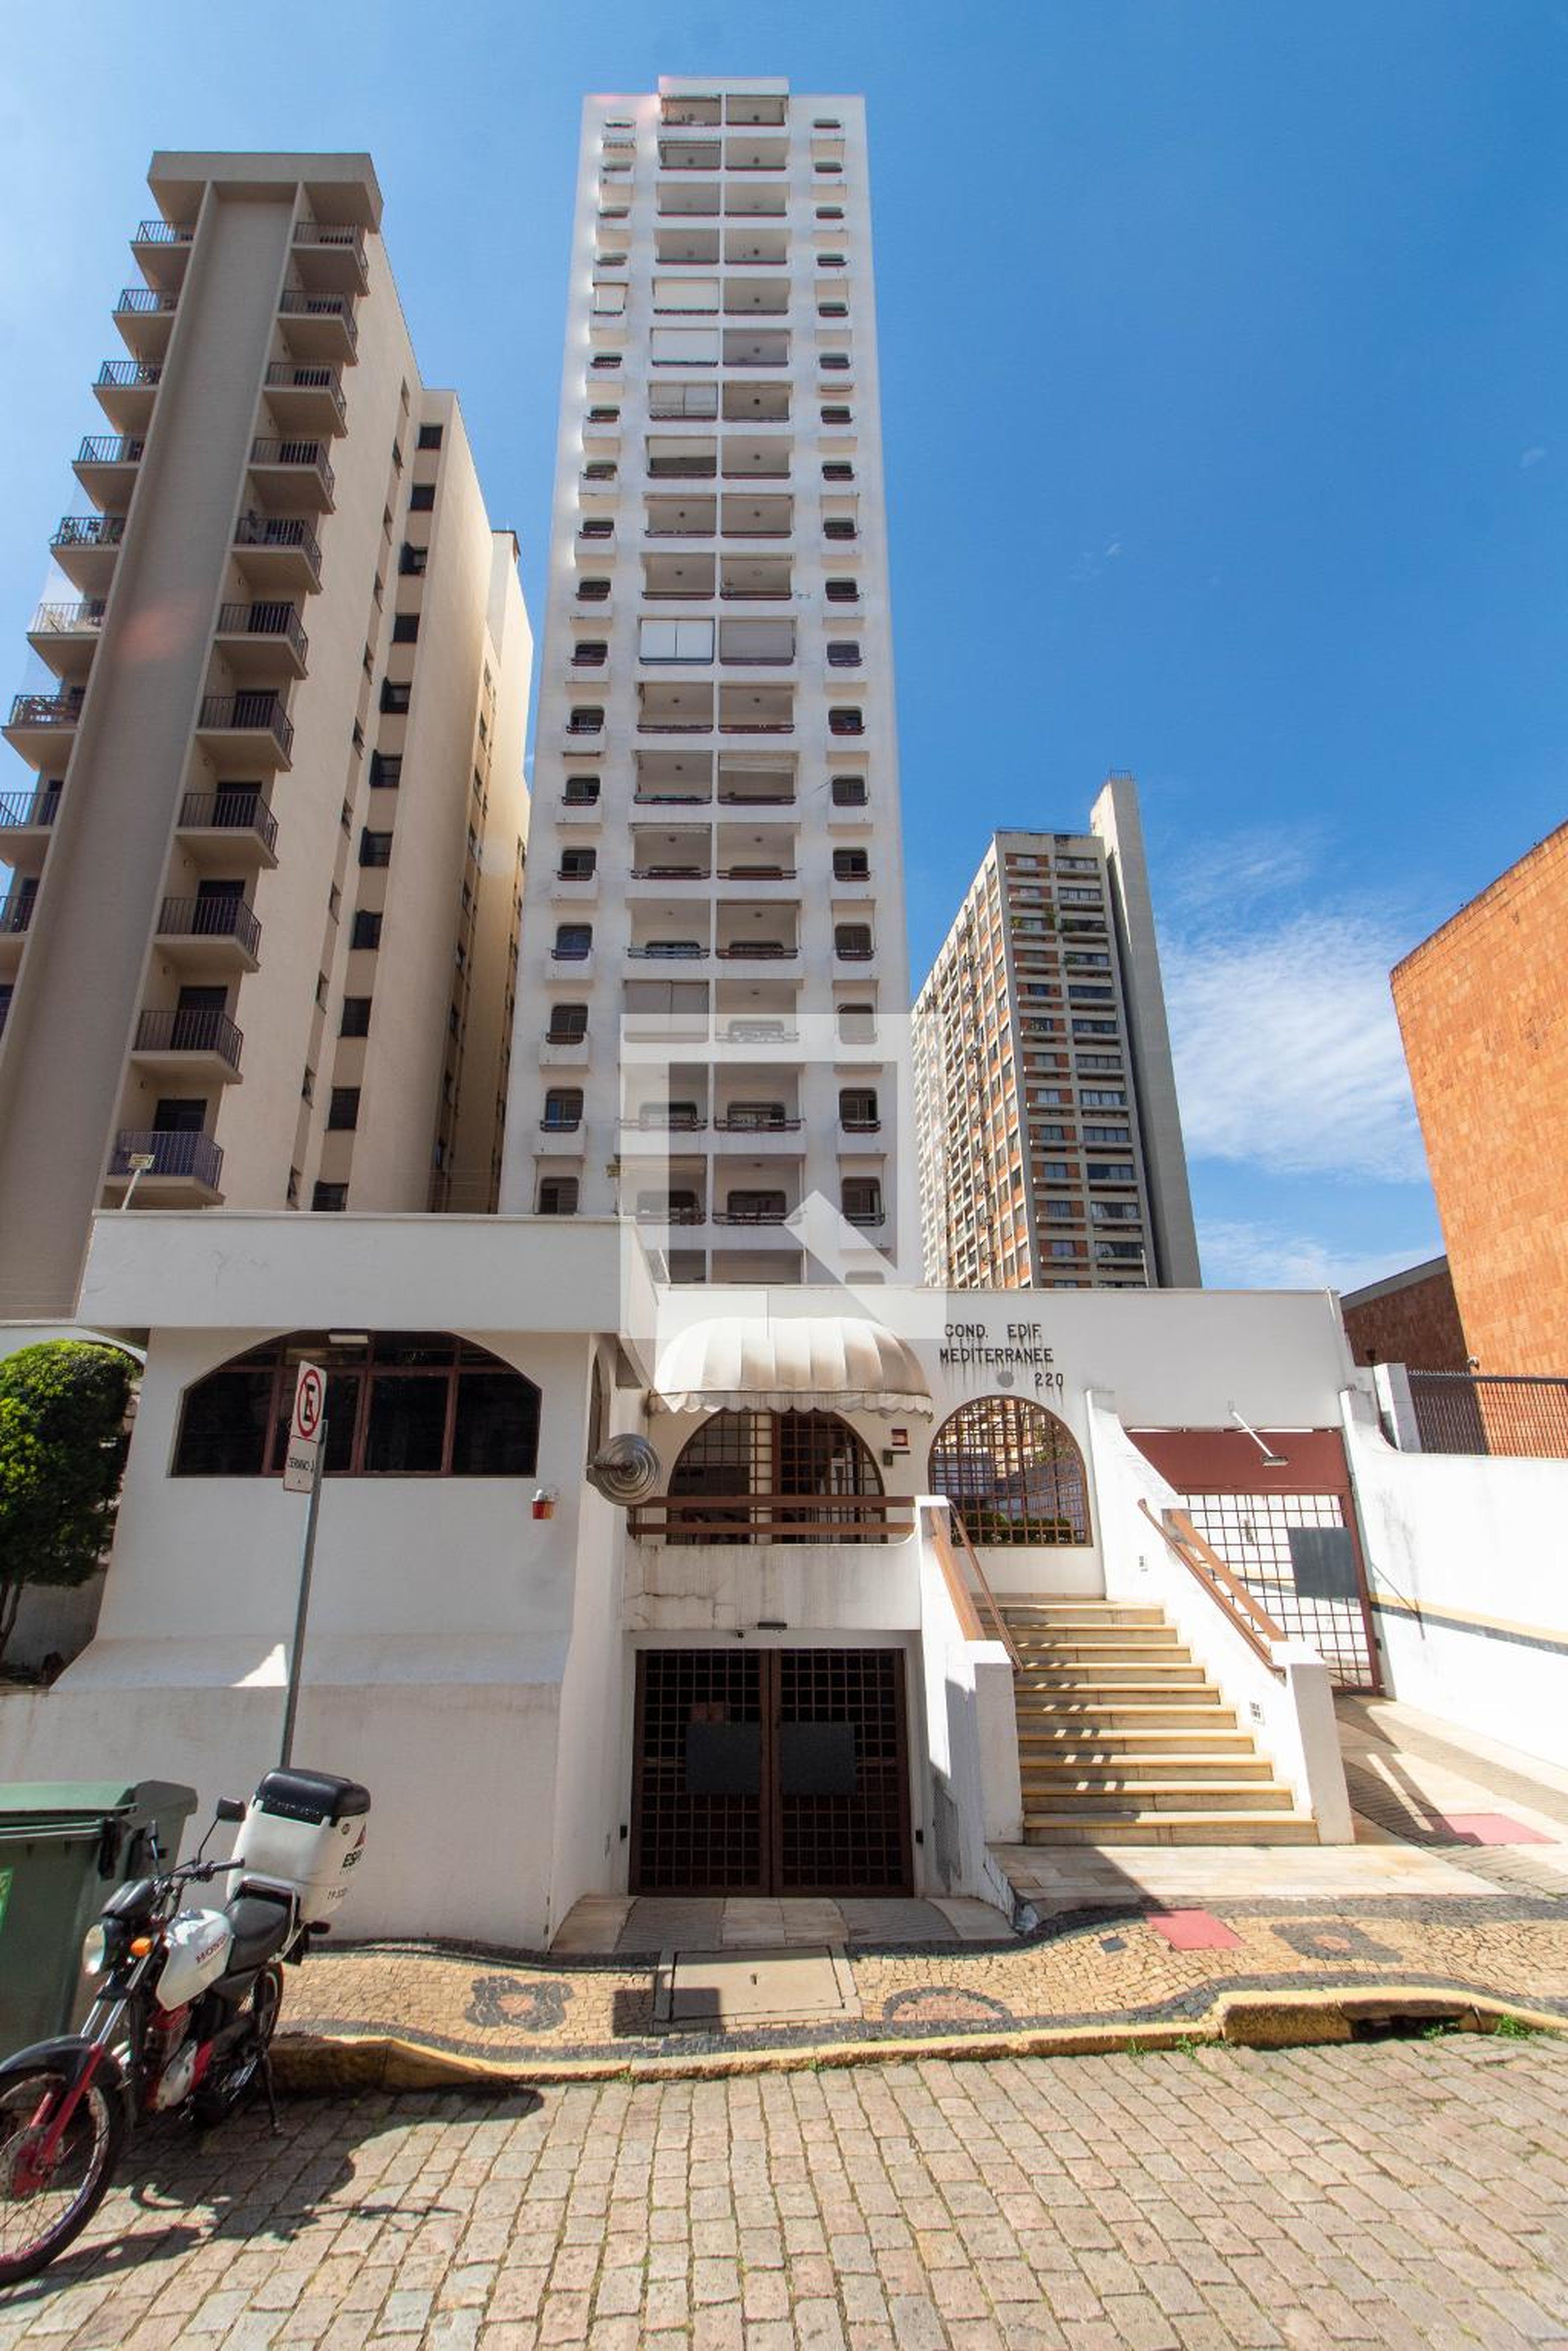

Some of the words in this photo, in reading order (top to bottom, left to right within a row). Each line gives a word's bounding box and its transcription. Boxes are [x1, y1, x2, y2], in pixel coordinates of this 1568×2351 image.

[944, 1324, 989, 1338] COND.
[1007, 1323, 1042, 1338] EDIF.
[940, 1348, 1054, 1363] MEDITERRANEE
[1034, 1372, 1063, 1387] 220
